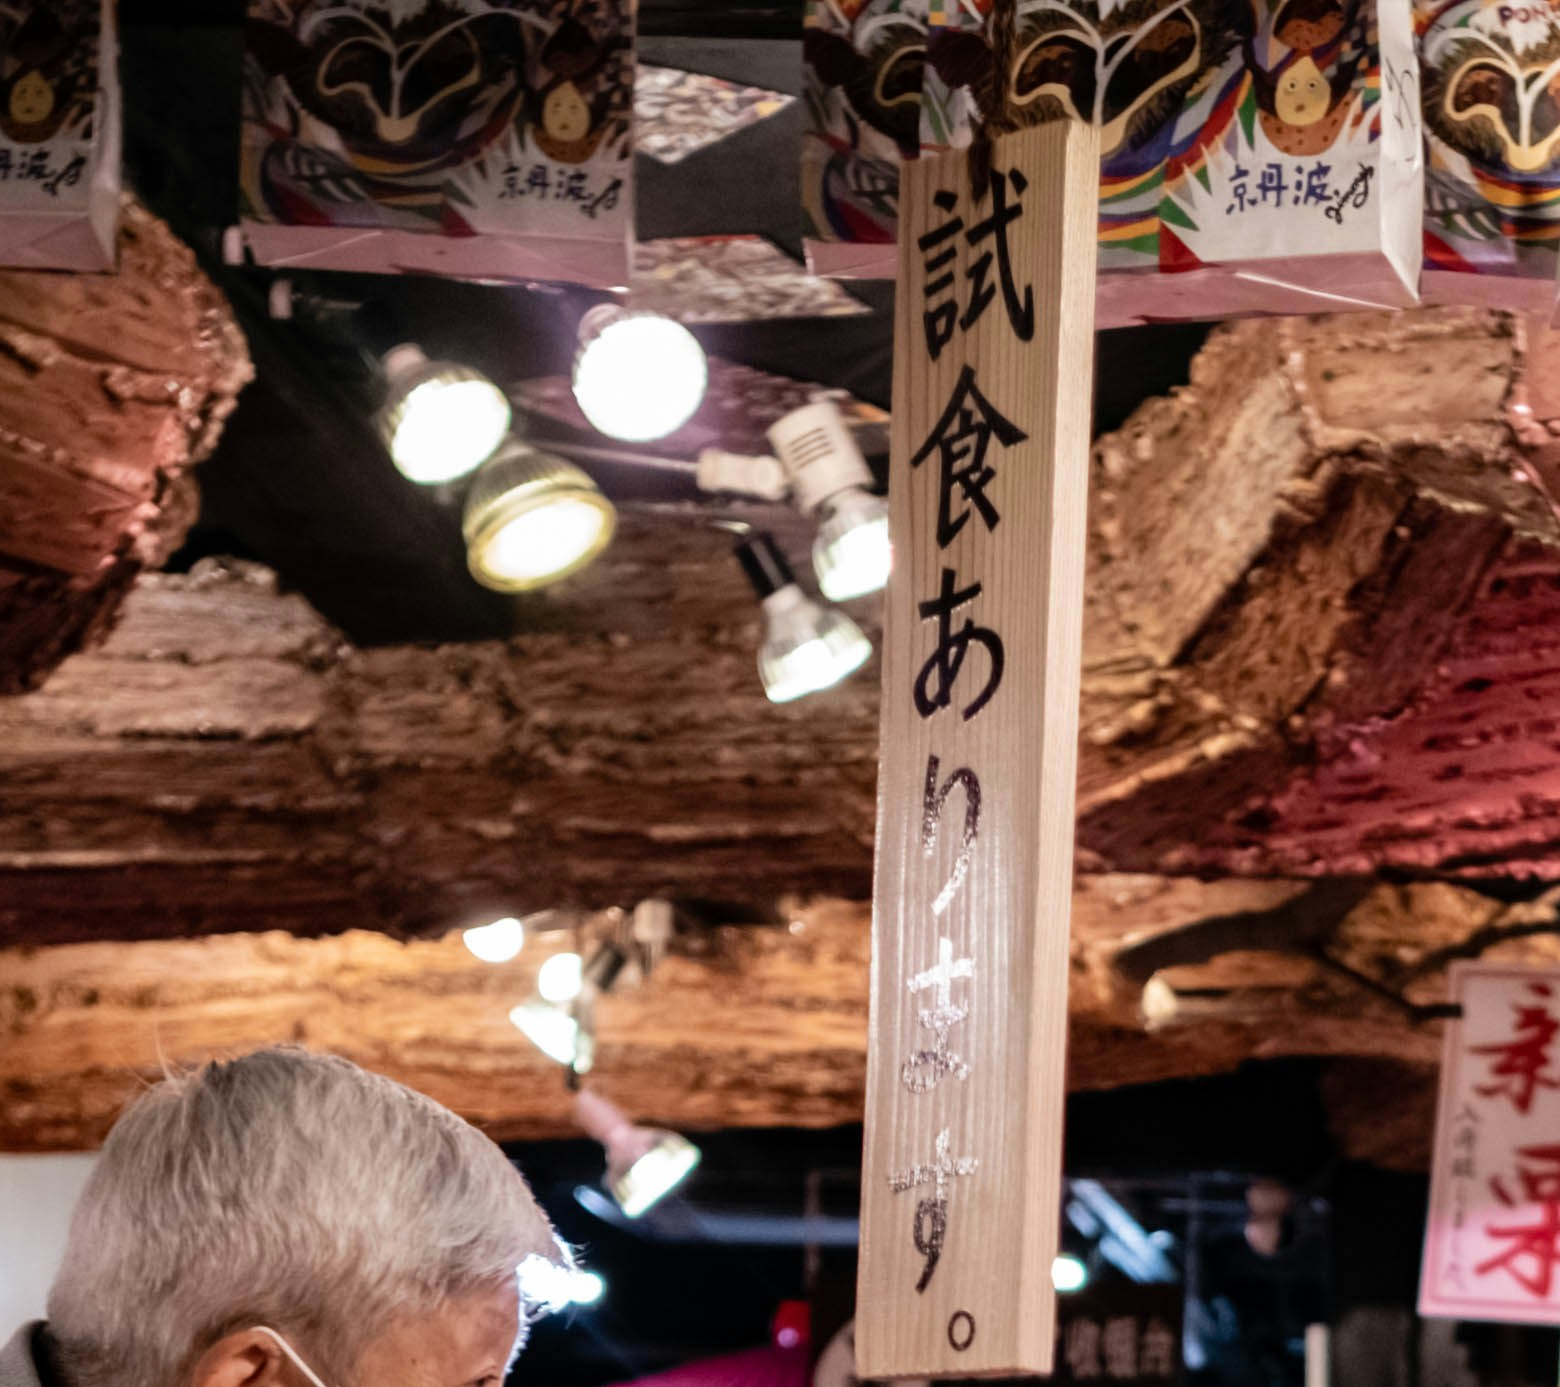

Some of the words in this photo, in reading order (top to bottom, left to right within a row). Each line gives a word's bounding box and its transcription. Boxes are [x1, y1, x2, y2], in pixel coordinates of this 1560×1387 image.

[1228, 163, 1332, 214] 京丹波
[888, 167, 1036, 1352] 試食あります。
